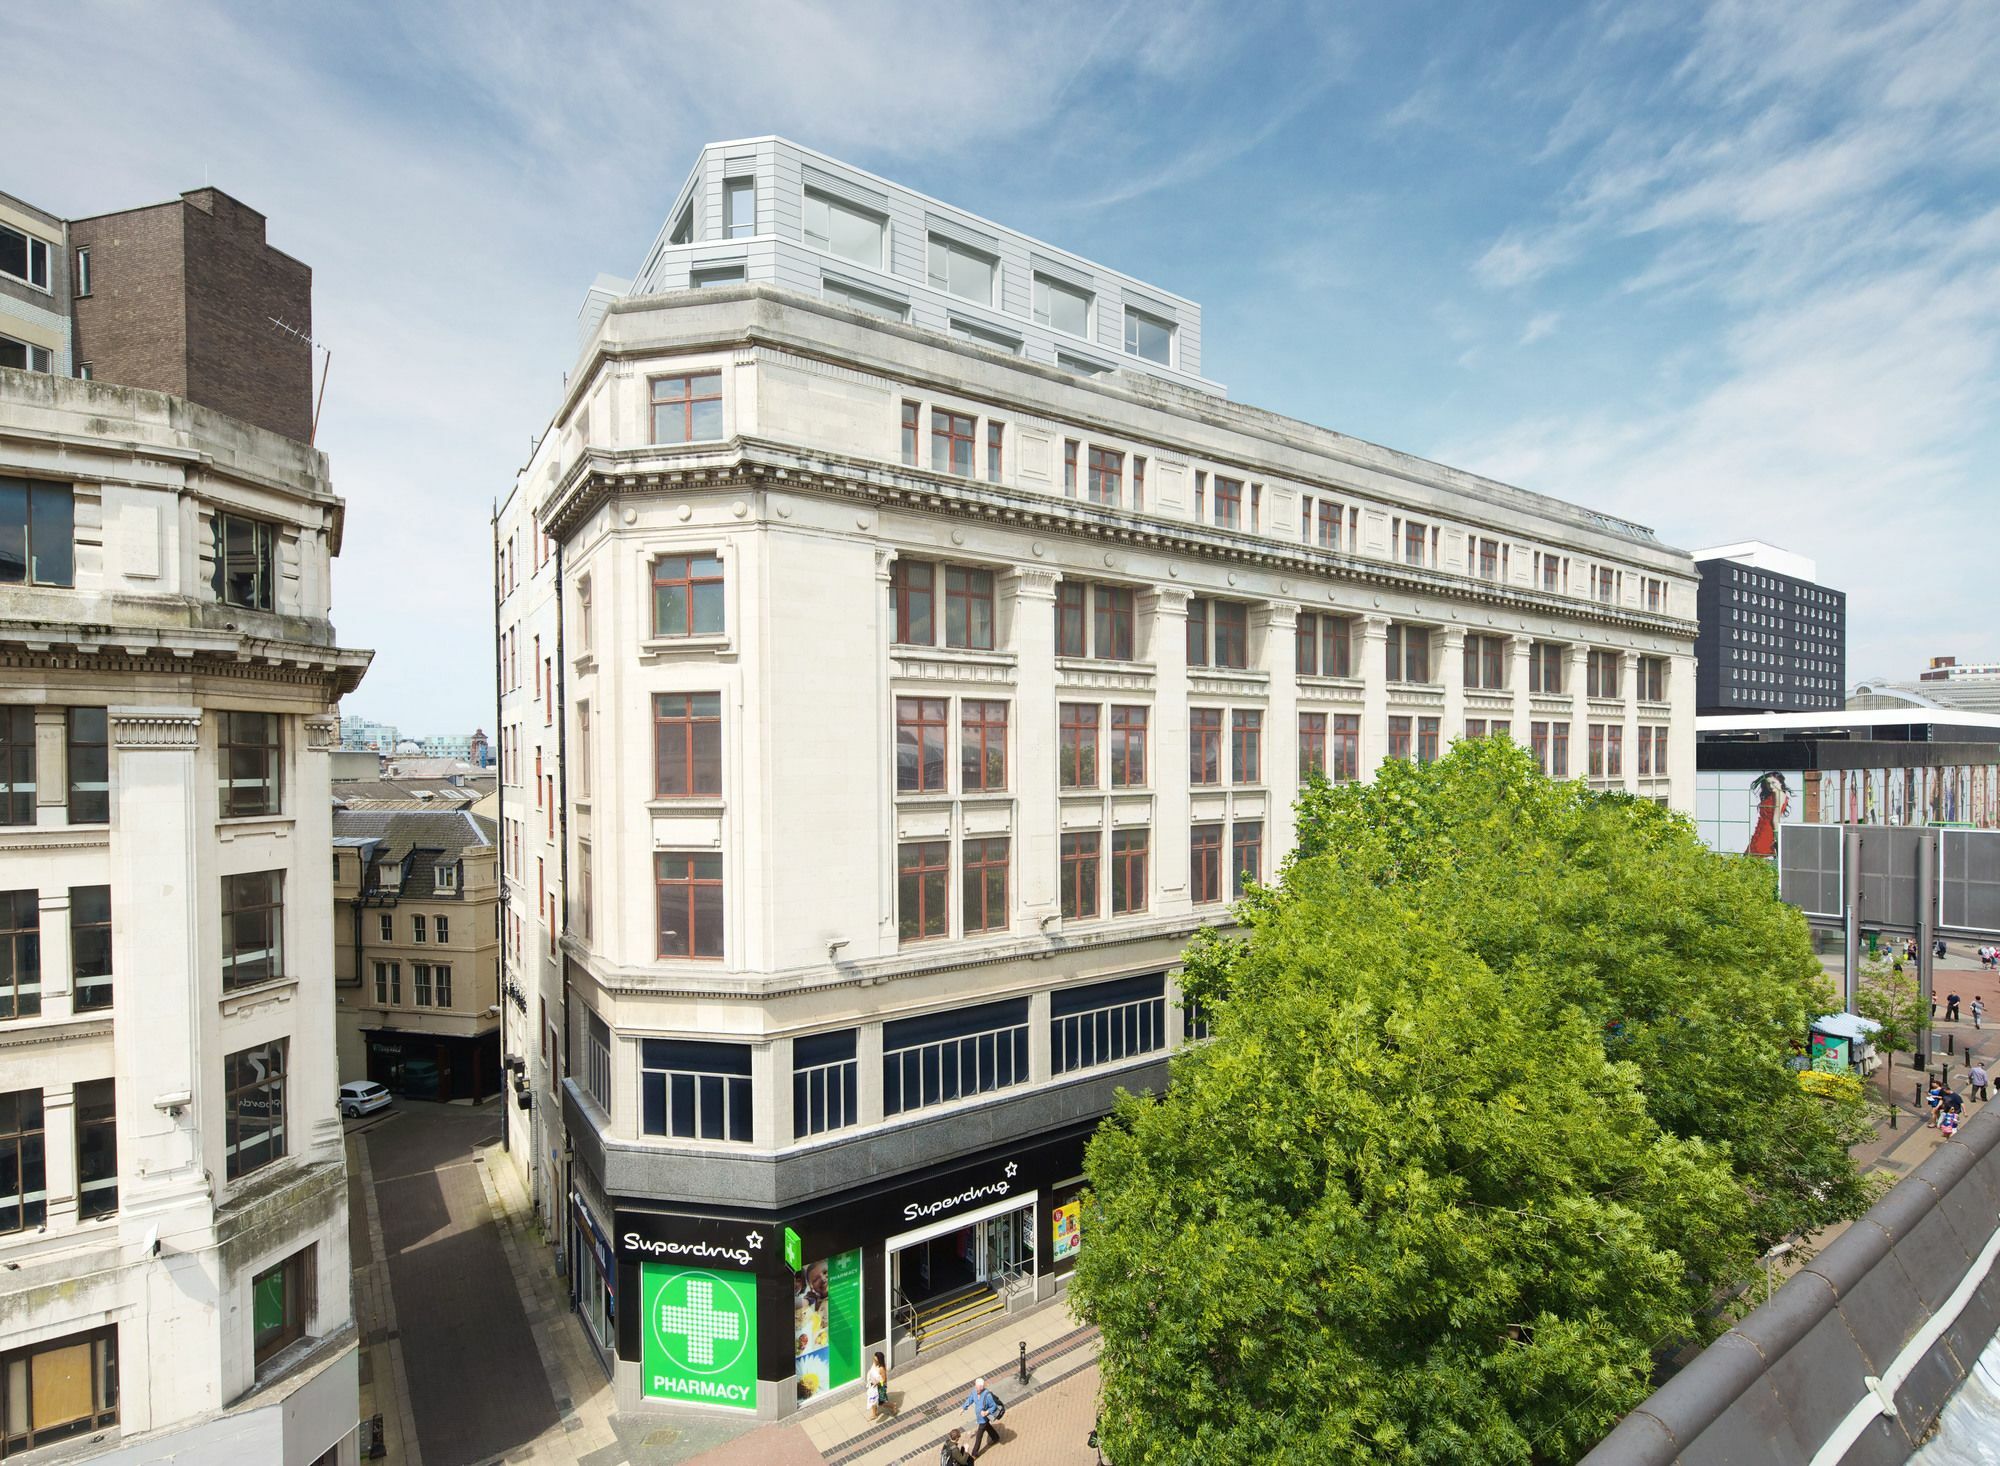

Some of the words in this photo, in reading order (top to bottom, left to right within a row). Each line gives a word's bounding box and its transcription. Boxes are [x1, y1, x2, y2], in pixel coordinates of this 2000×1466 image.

[903, 1181, 1010, 1221] Superdrug
[623, 1232, 752, 1265] Superdrug
[653, 1375, 750, 1401] PHARMACY
